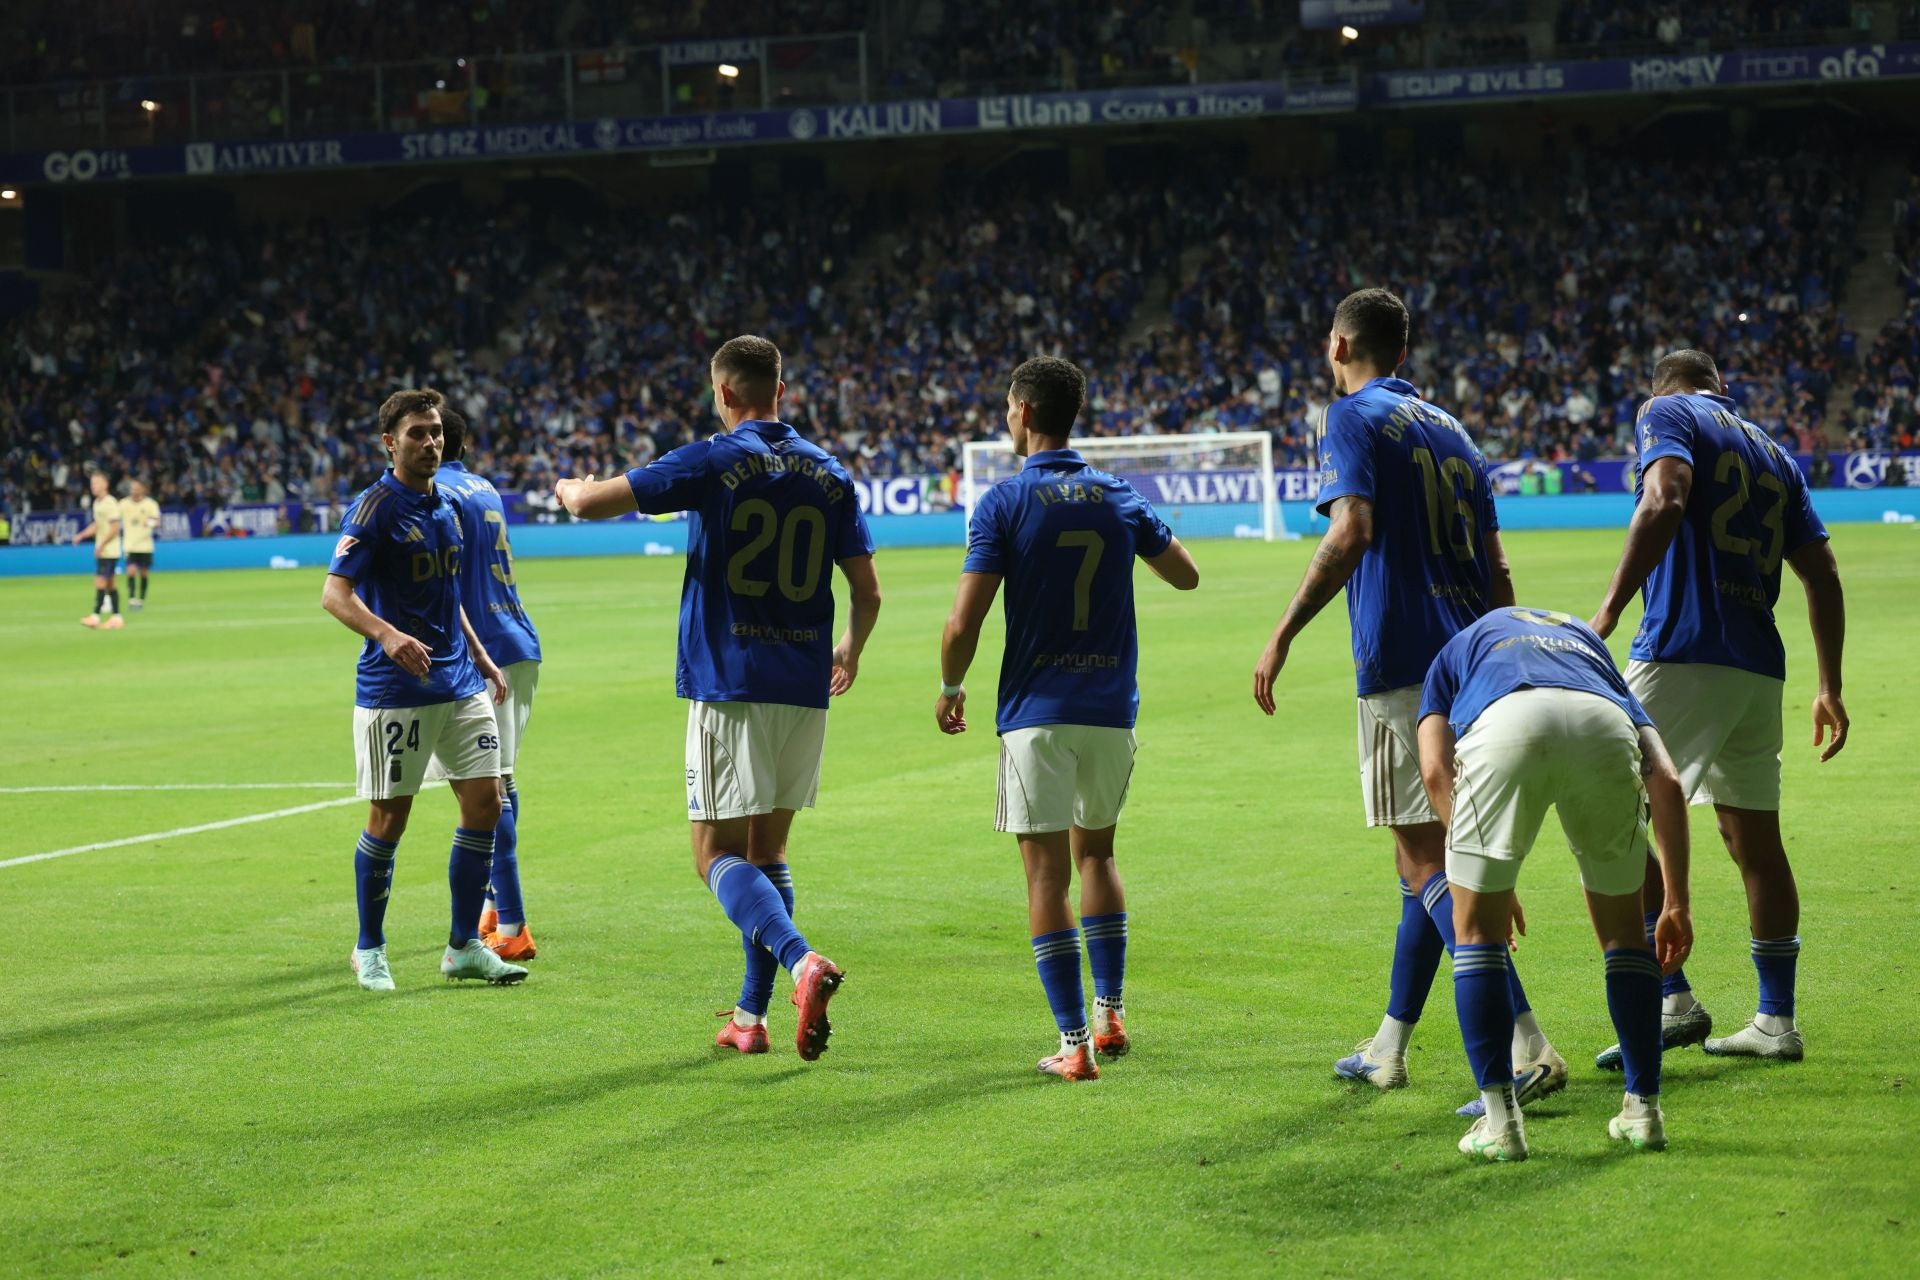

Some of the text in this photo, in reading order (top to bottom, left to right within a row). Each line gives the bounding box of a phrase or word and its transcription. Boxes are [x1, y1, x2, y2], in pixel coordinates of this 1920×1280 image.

[484, 123, 582, 154] MEDICAL
[827, 100, 942, 138] KALIUN
[1035, 483, 1106, 507] ILYAS
[1410, 446, 1477, 563] 16
[1710, 450, 1789, 577] 23
[484, 509, 517, 587] 3
[726, 497, 827, 603] 20
[1055, 529, 1106, 632] 7
[386, 719, 421, 755] 24
